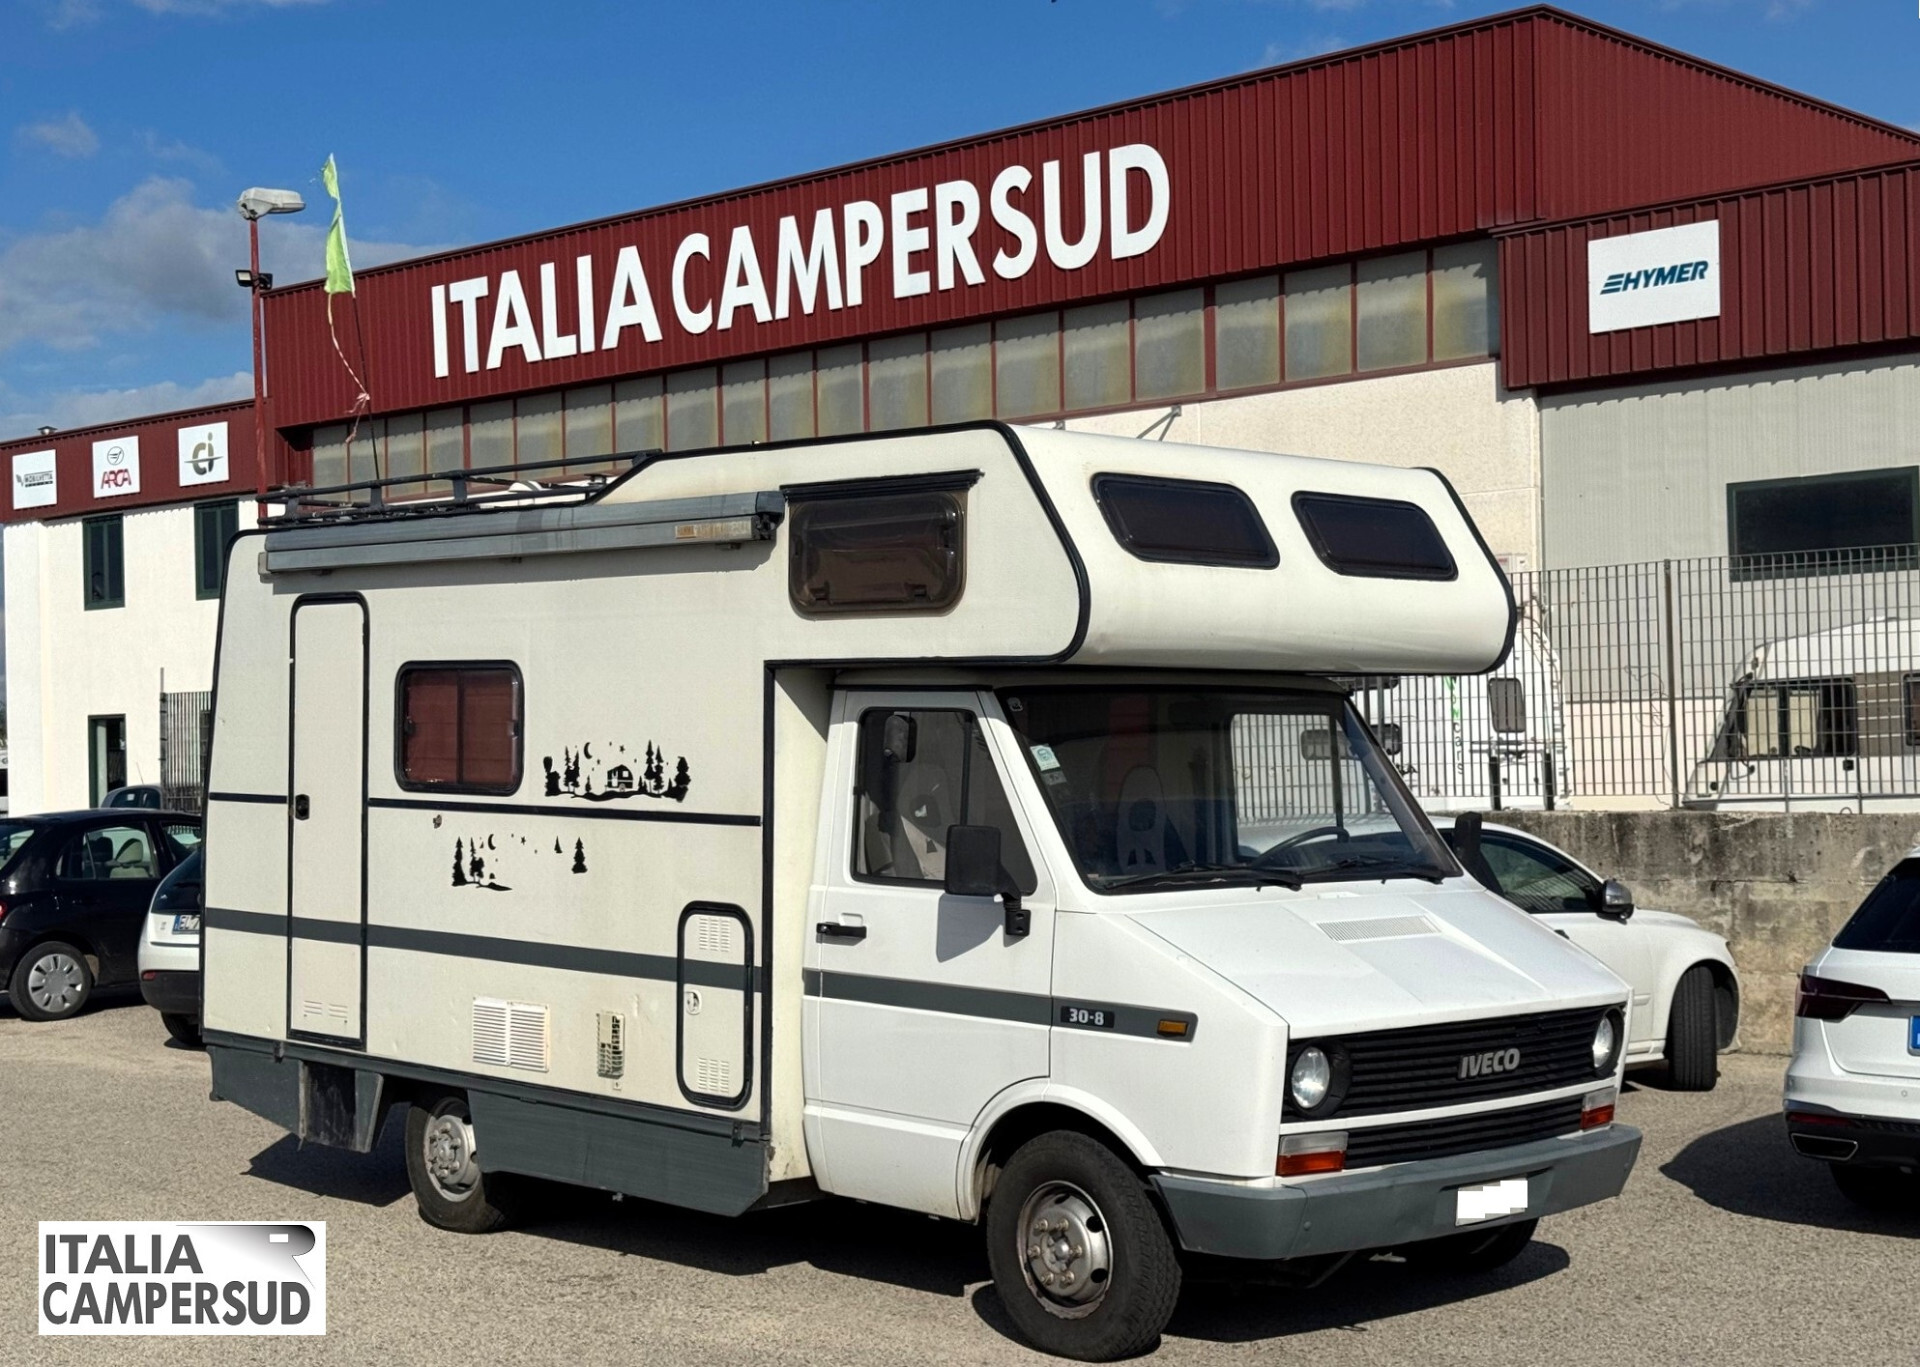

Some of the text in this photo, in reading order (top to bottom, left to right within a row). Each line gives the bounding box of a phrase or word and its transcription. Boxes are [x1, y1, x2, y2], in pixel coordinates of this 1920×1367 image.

[430, 143, 1171, 378] ITALIA CAMPERSUD
[1621, 259, 1710, 292] HYMER
[100, 467, 132, 490] ARCA
[1068, 1008, 1105, 1026] 30-8
[1458, 1047, 1521, 1079] IVECO
